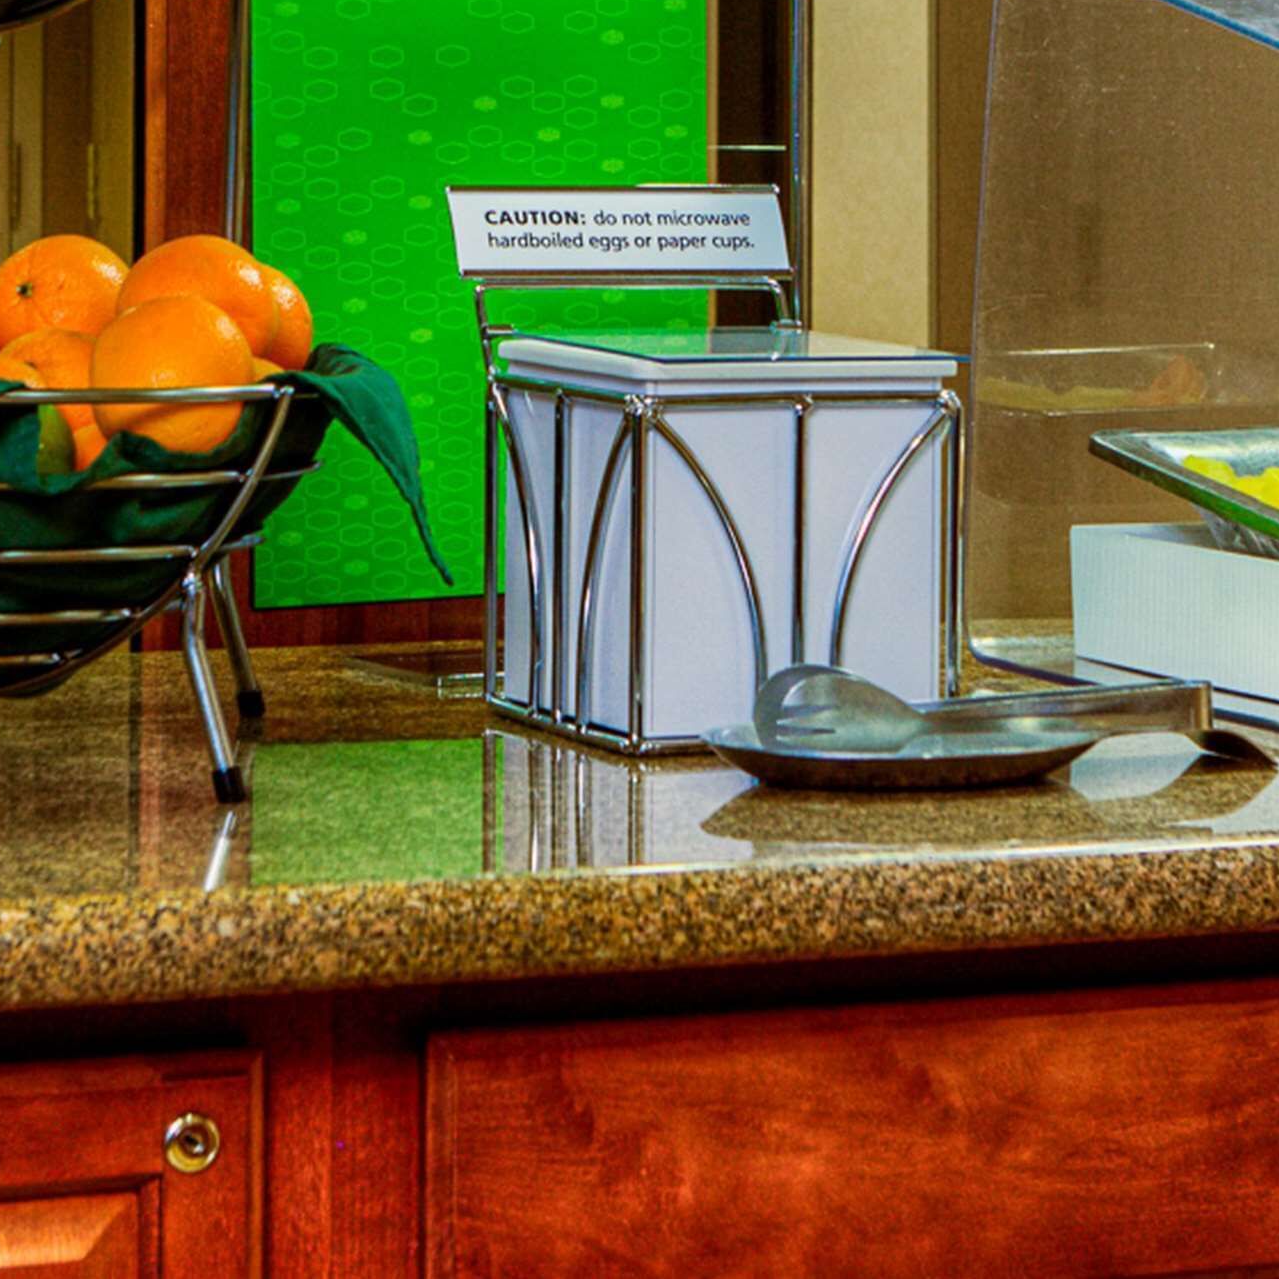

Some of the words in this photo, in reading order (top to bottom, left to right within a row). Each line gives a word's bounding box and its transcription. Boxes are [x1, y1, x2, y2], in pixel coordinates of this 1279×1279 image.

[484, 209, 586, 226] CAUTION:
[593, 210, 617, 226] do
[622, 211, 652, 226] not
[657, 210, 751, 226] microwave
[488, 232, 584, 249] hardboiled
[588, 236, 630, 252] eggs
[634, 236, 651, 249] or
[657, 236, 706, 252] paper
[711, 236, 755, 252] cups.
